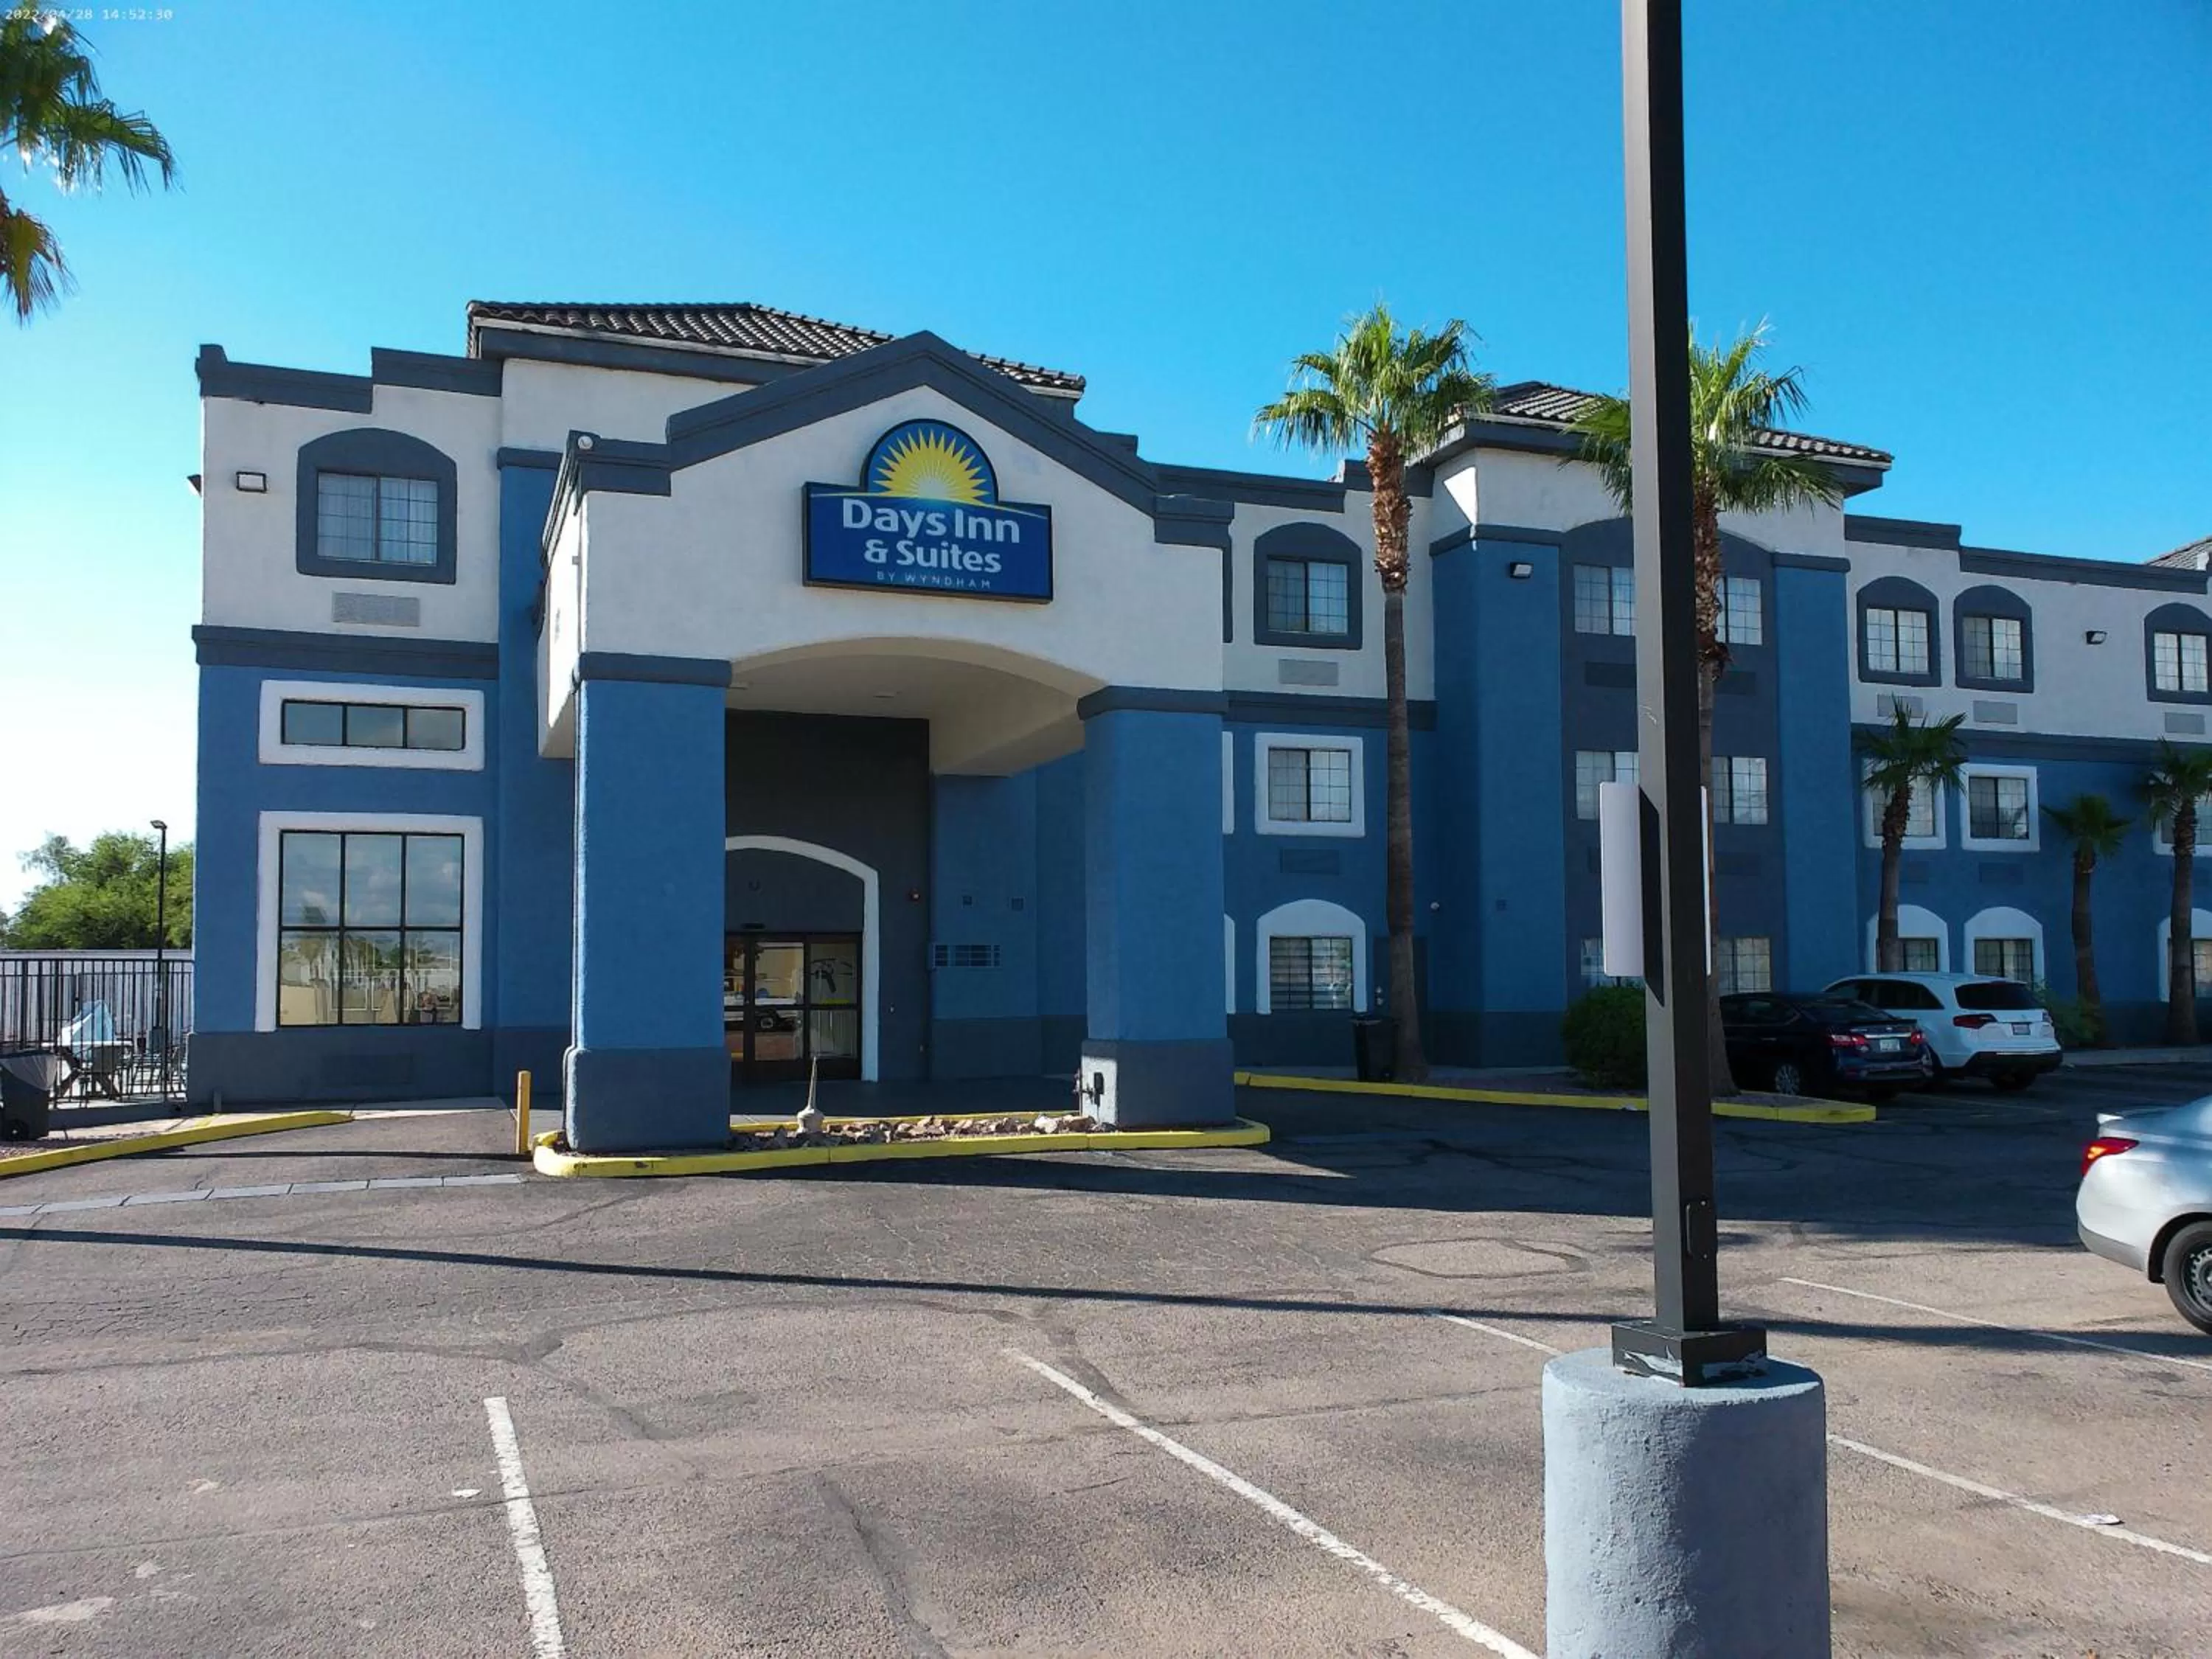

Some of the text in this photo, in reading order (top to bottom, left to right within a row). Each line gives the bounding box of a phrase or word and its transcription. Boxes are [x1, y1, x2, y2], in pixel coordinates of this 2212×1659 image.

[843, 498, 1020, 543] Days Inn
[865, 539, 1002, 573] & Suites
[877, 571, 991, 589] BY WYNDHAM
